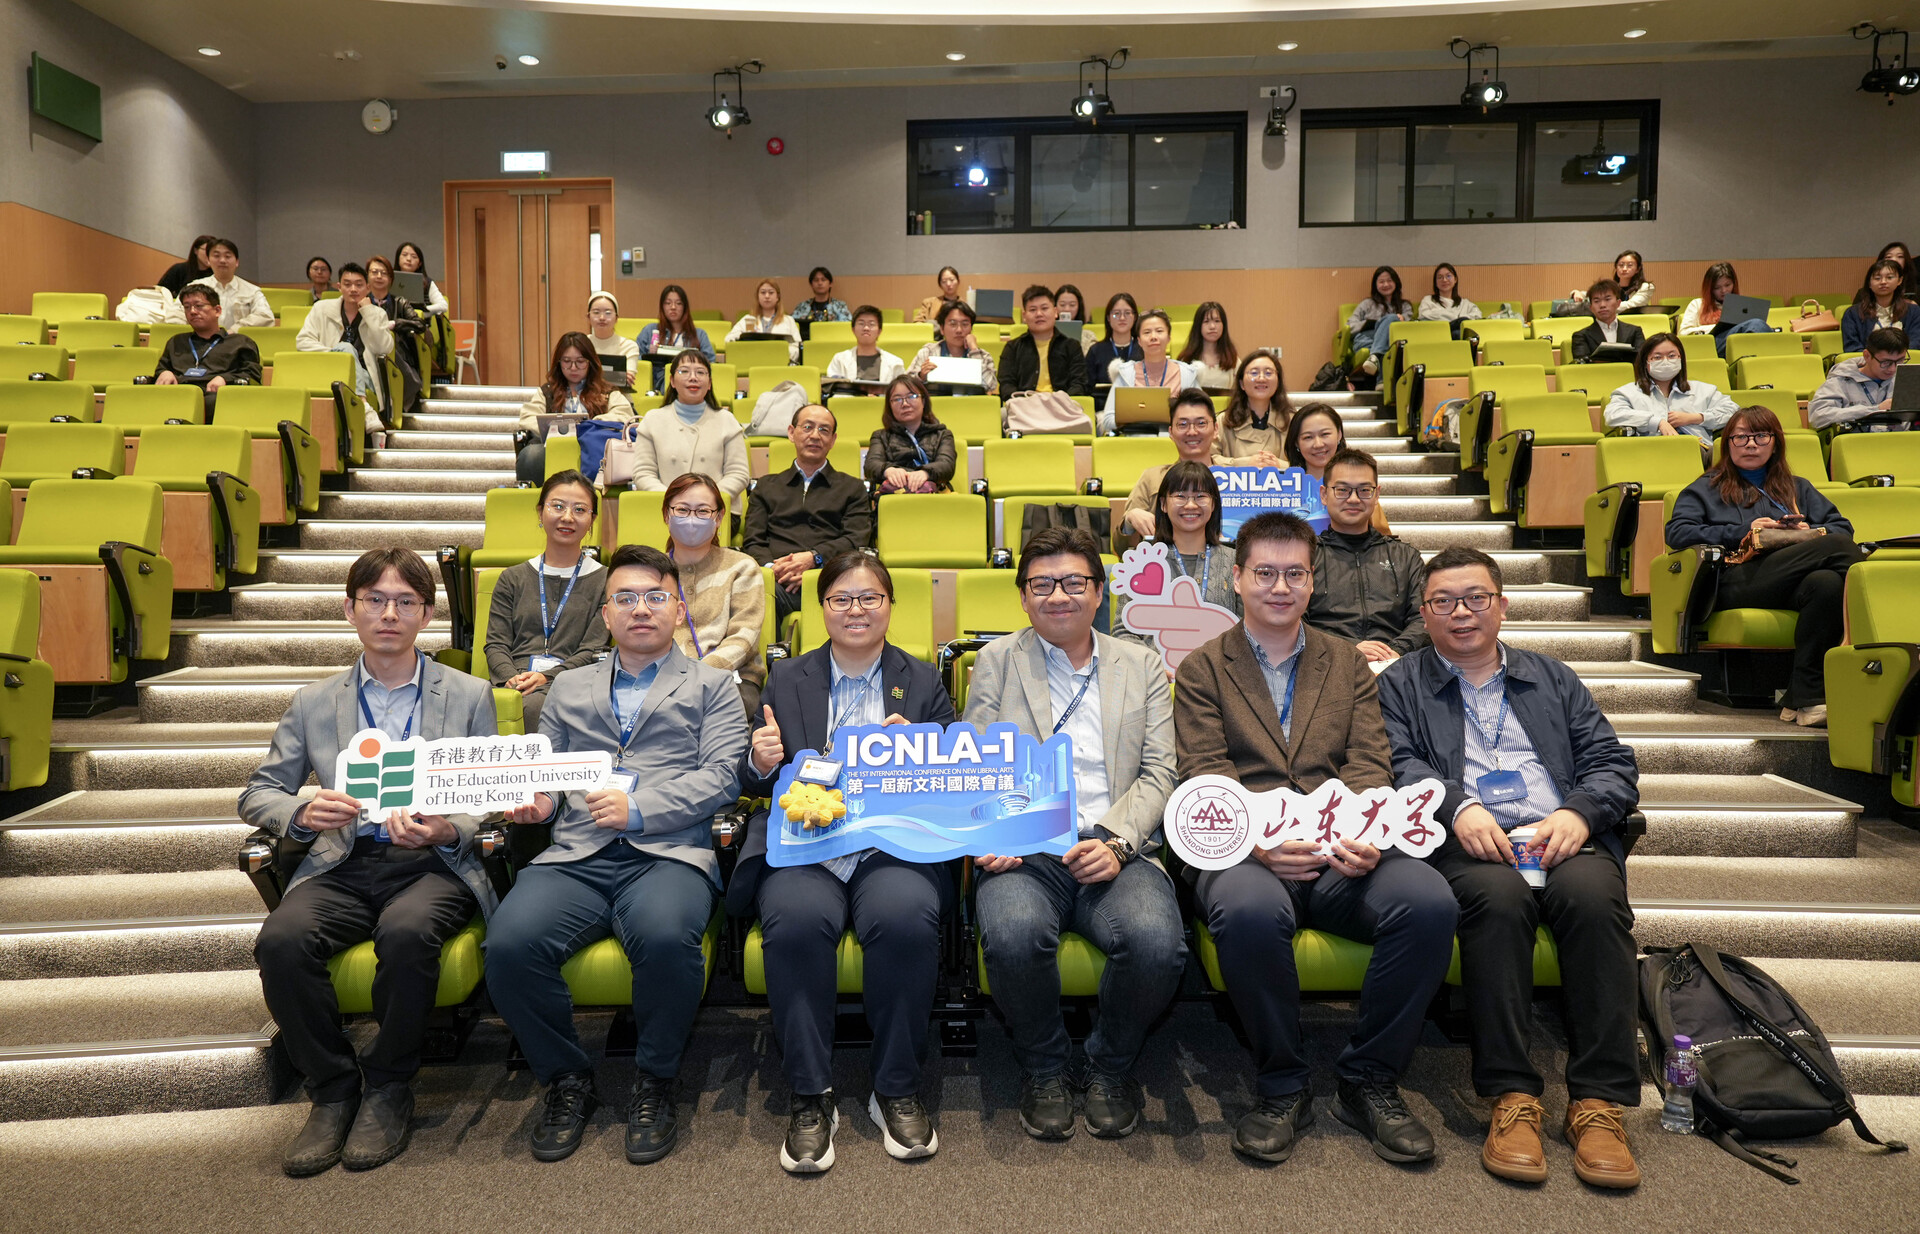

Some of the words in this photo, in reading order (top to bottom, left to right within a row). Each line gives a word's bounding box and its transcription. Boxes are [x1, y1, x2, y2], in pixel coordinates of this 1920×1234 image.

[1212, 471, 1302, 491] CNLA-1
[1222, 498, 1301, 507] 屆新文科國際會議
[428, 743, 542, 766] 香港教育大學
[847, 731, 1014, 767] ICNLA-1
[426, 775, 454, 788] The
[457, 771, 527, 787] Education
[530, 767, 602, 783] University
[870, 769, 913, 777] INTERNATIONAL
[914, 768, 951, 776] CONFERENCE
[425, 791, 443, 806] of
[444, 791, 483, 807] Hong
[486, 789, 524, 804] Kong
[1180, 825, 1211, 855] SHANDONG
[1213, 826, 1245, 855] UNIVERSITY
